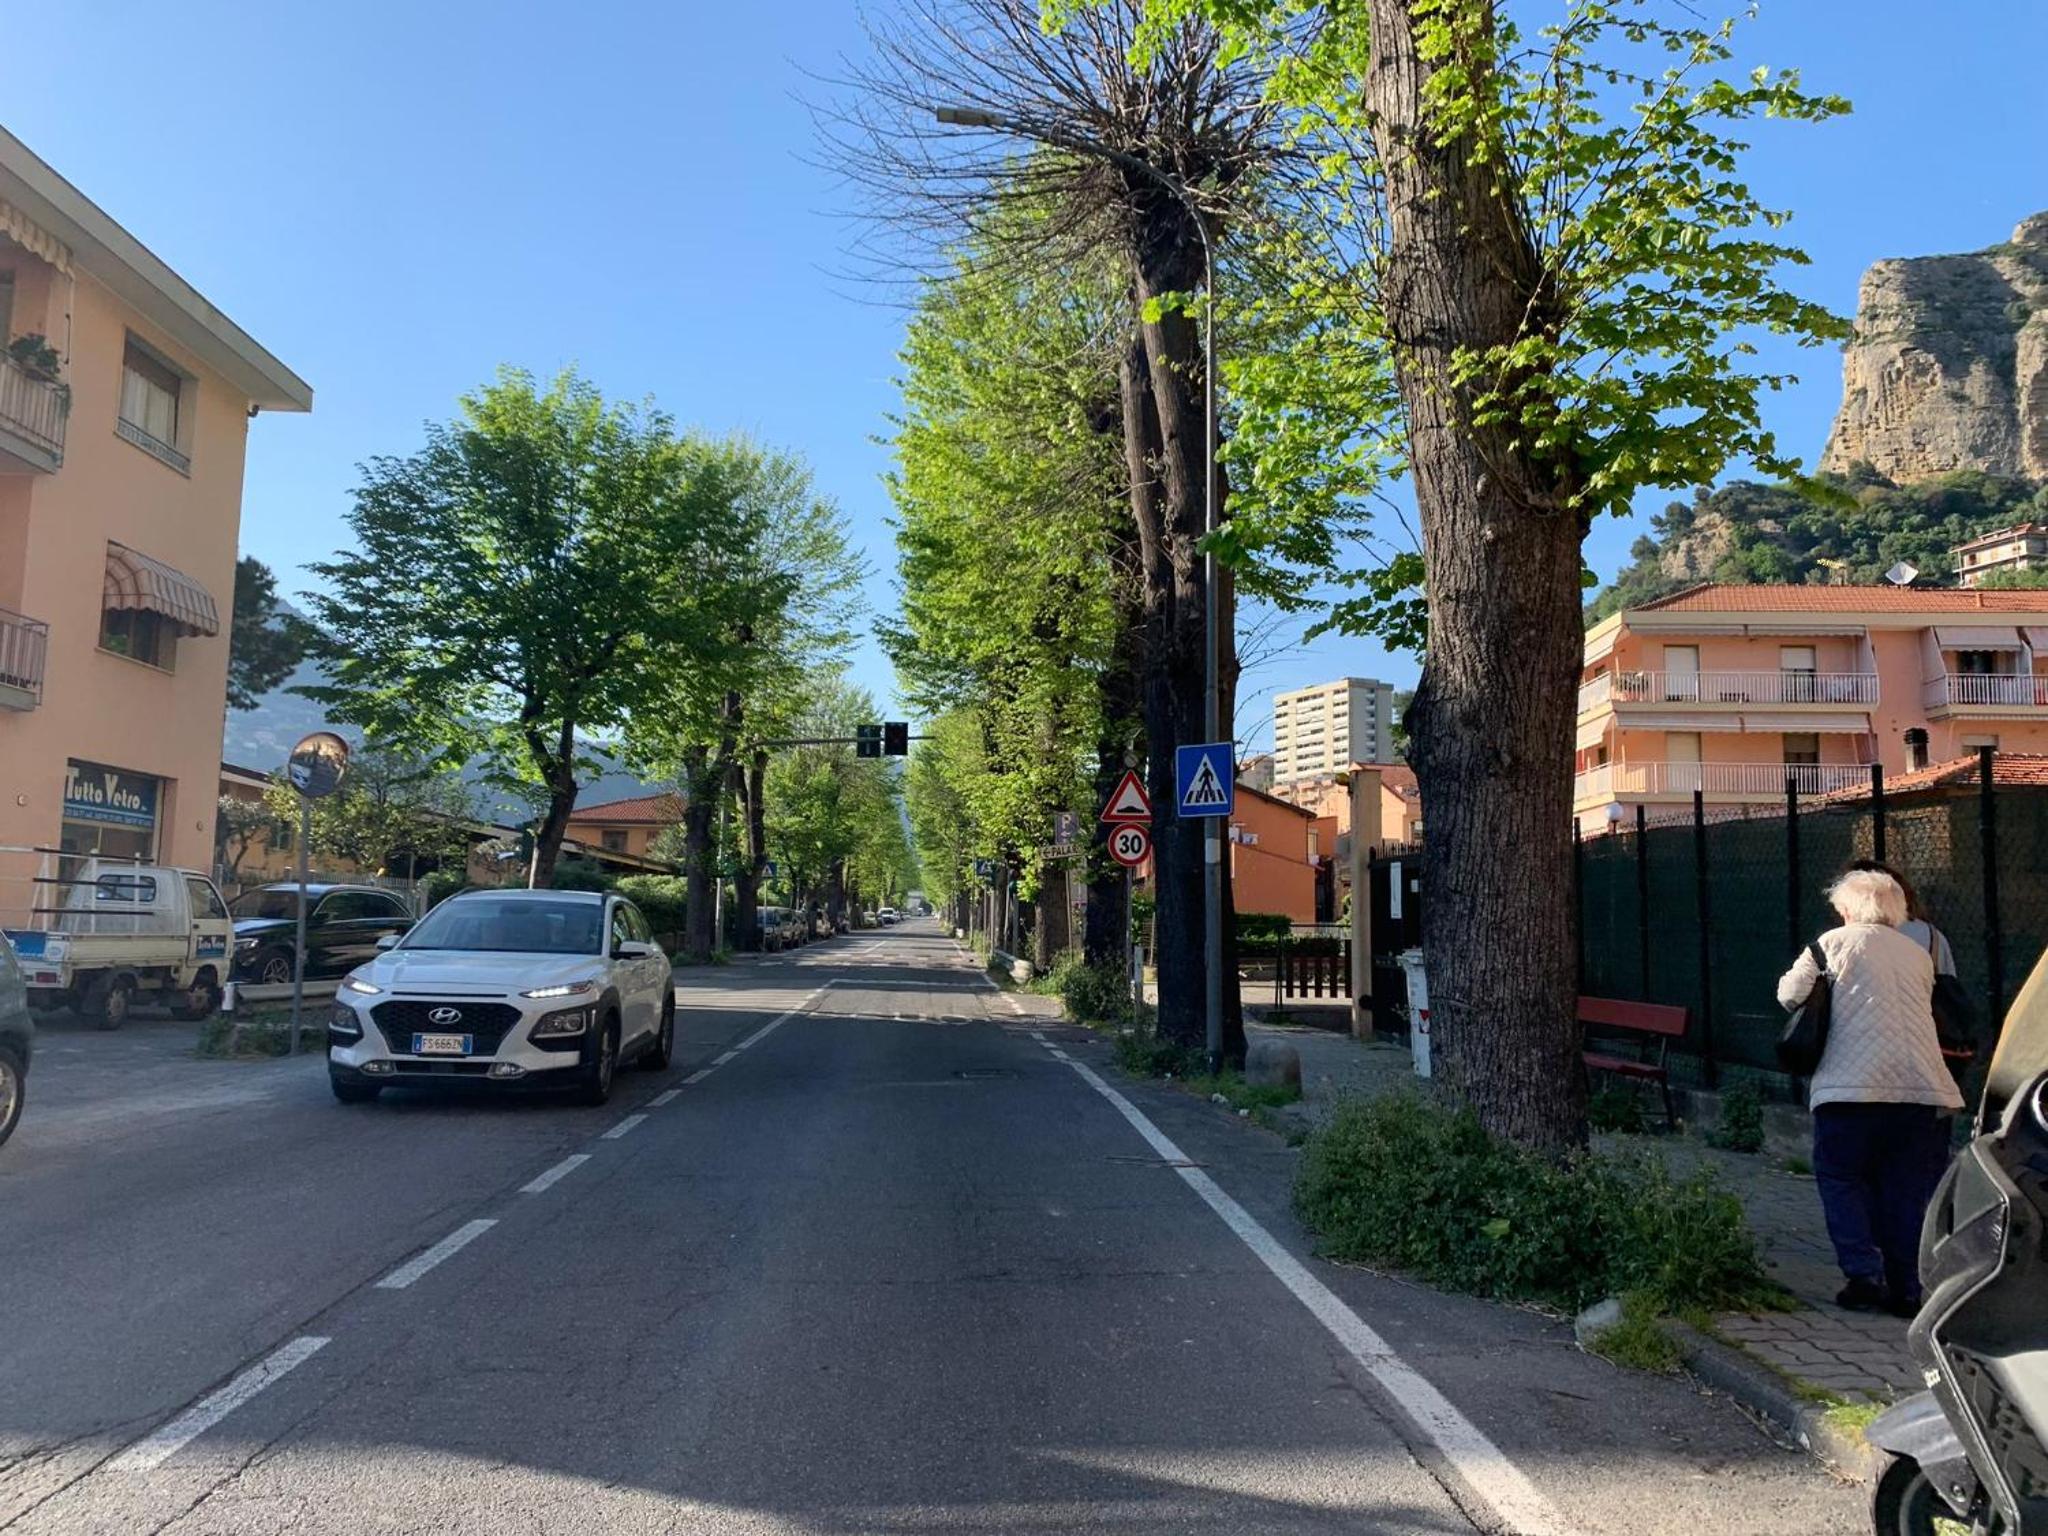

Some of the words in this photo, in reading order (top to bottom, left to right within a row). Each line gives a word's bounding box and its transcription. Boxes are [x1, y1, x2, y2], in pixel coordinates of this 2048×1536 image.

[66, 766, 103, 804] Tutto
[104, 773, 140, 810] Vetro
[1119, 834, 1142, 854] 30
